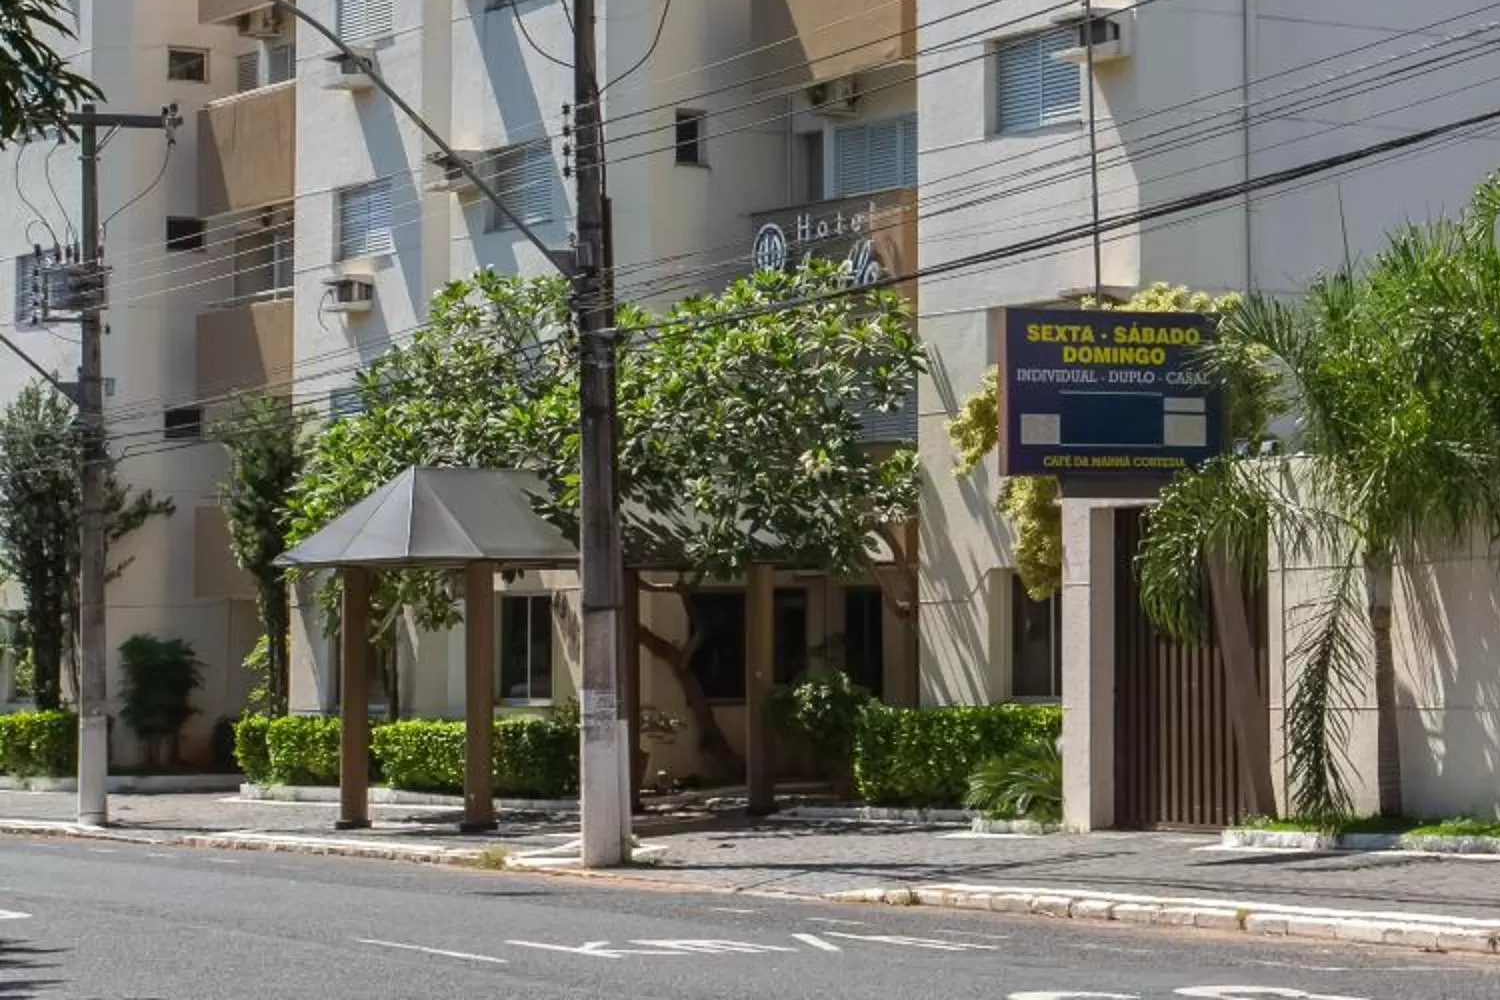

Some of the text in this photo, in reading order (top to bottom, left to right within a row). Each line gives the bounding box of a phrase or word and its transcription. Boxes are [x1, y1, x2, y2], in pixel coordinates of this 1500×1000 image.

[797, 201, 876, 241] Hotel
[1026, 322, 1201, 345] SEXTA SÁBADO
[1062, 346, 1167, 365] DOMINGO
[1016, 368, 1097, 383] INDIVIDUAL
[1108, 370, 1155, 384] DUPLO
